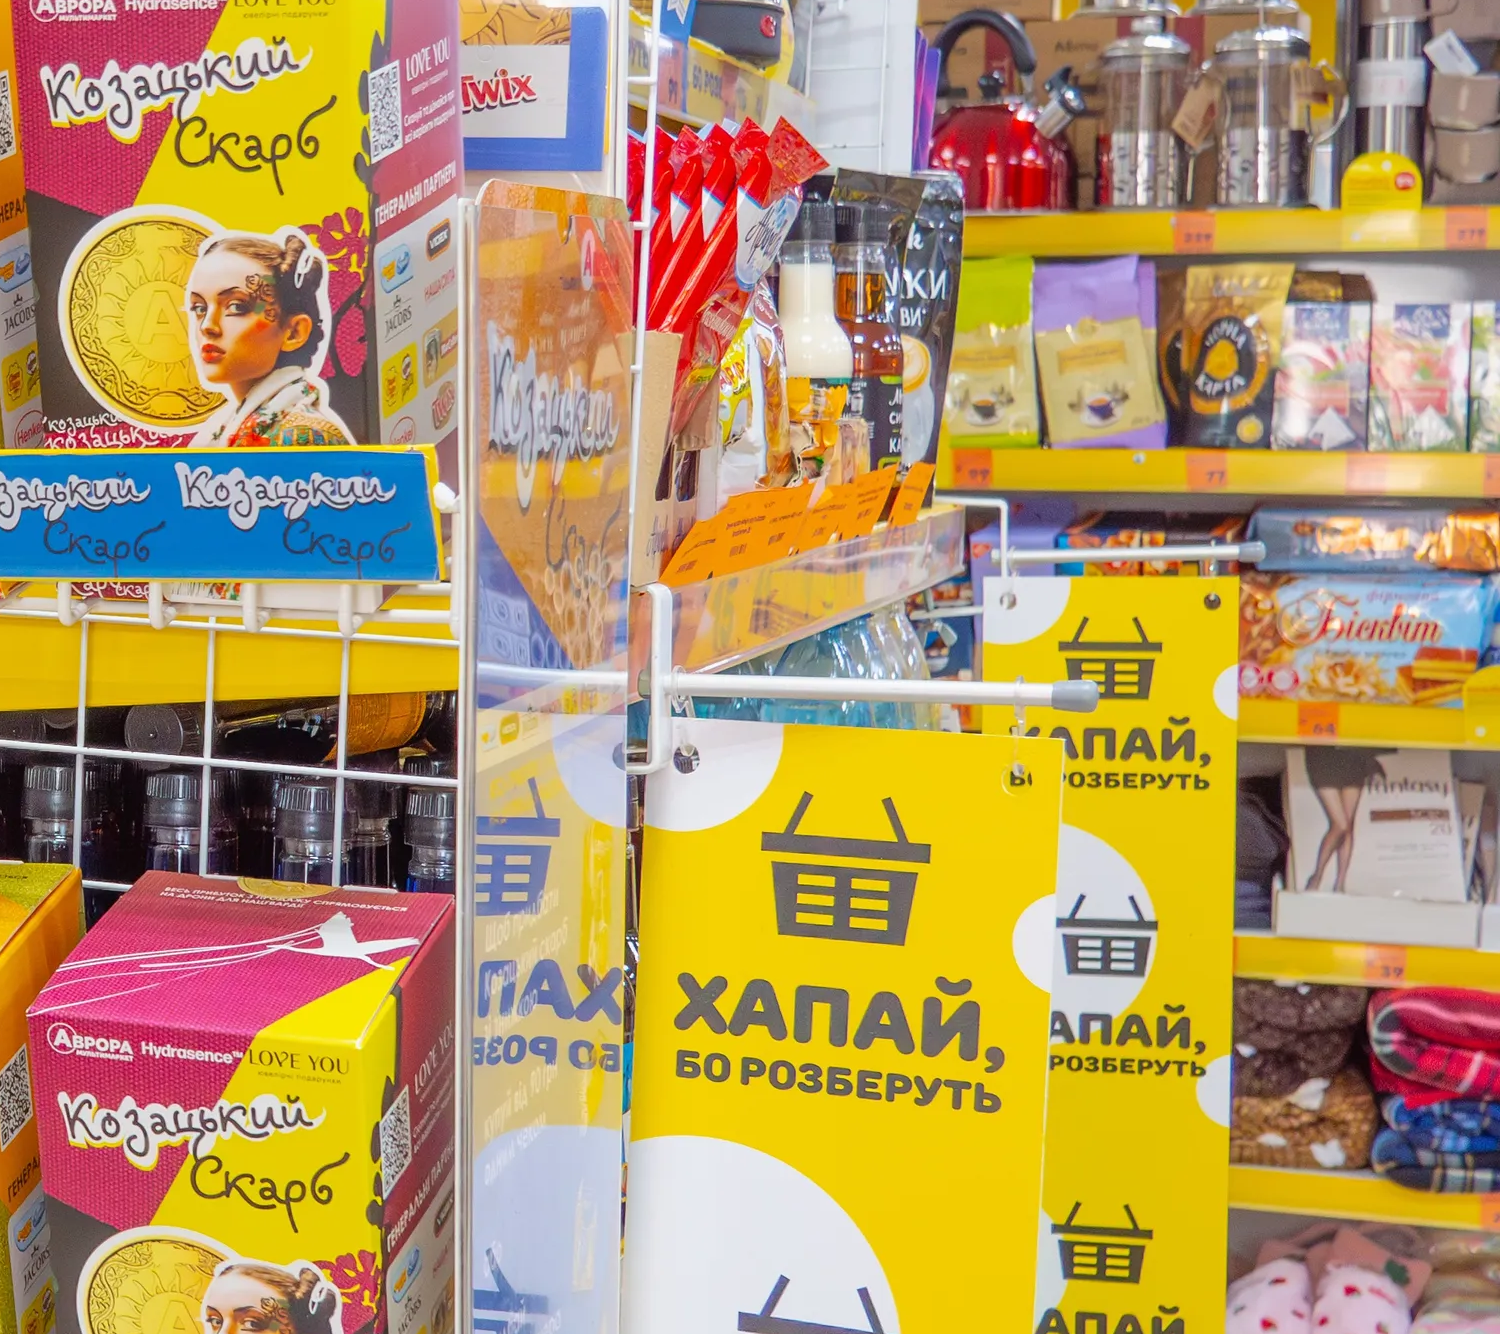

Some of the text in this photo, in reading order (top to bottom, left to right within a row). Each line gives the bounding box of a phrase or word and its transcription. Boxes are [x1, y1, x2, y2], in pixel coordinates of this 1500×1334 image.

[40, 35, 313, 141] Козацький
[174, 95, 338, 196] Скарб
[385, 304, 412, 337] JACOBS
[175, 462, 397, 531] Козацький
[43, 519, 166, 578] Скарб
[282, 519, 411, 579] Скарб
[1062, 772, 1211, 791] ОЗБЕРУТЬ
[675, 971, 1005, 1073] ХАПАЙ,
[248, 1049, 350, 1075] LOVE YOU
[676, 1050, 1002, 1115] БО РОЗБЕРУТЬ
[58, 1092, 326, 1172] Козацький
[190, 1152, 350, 1233] Скарб
